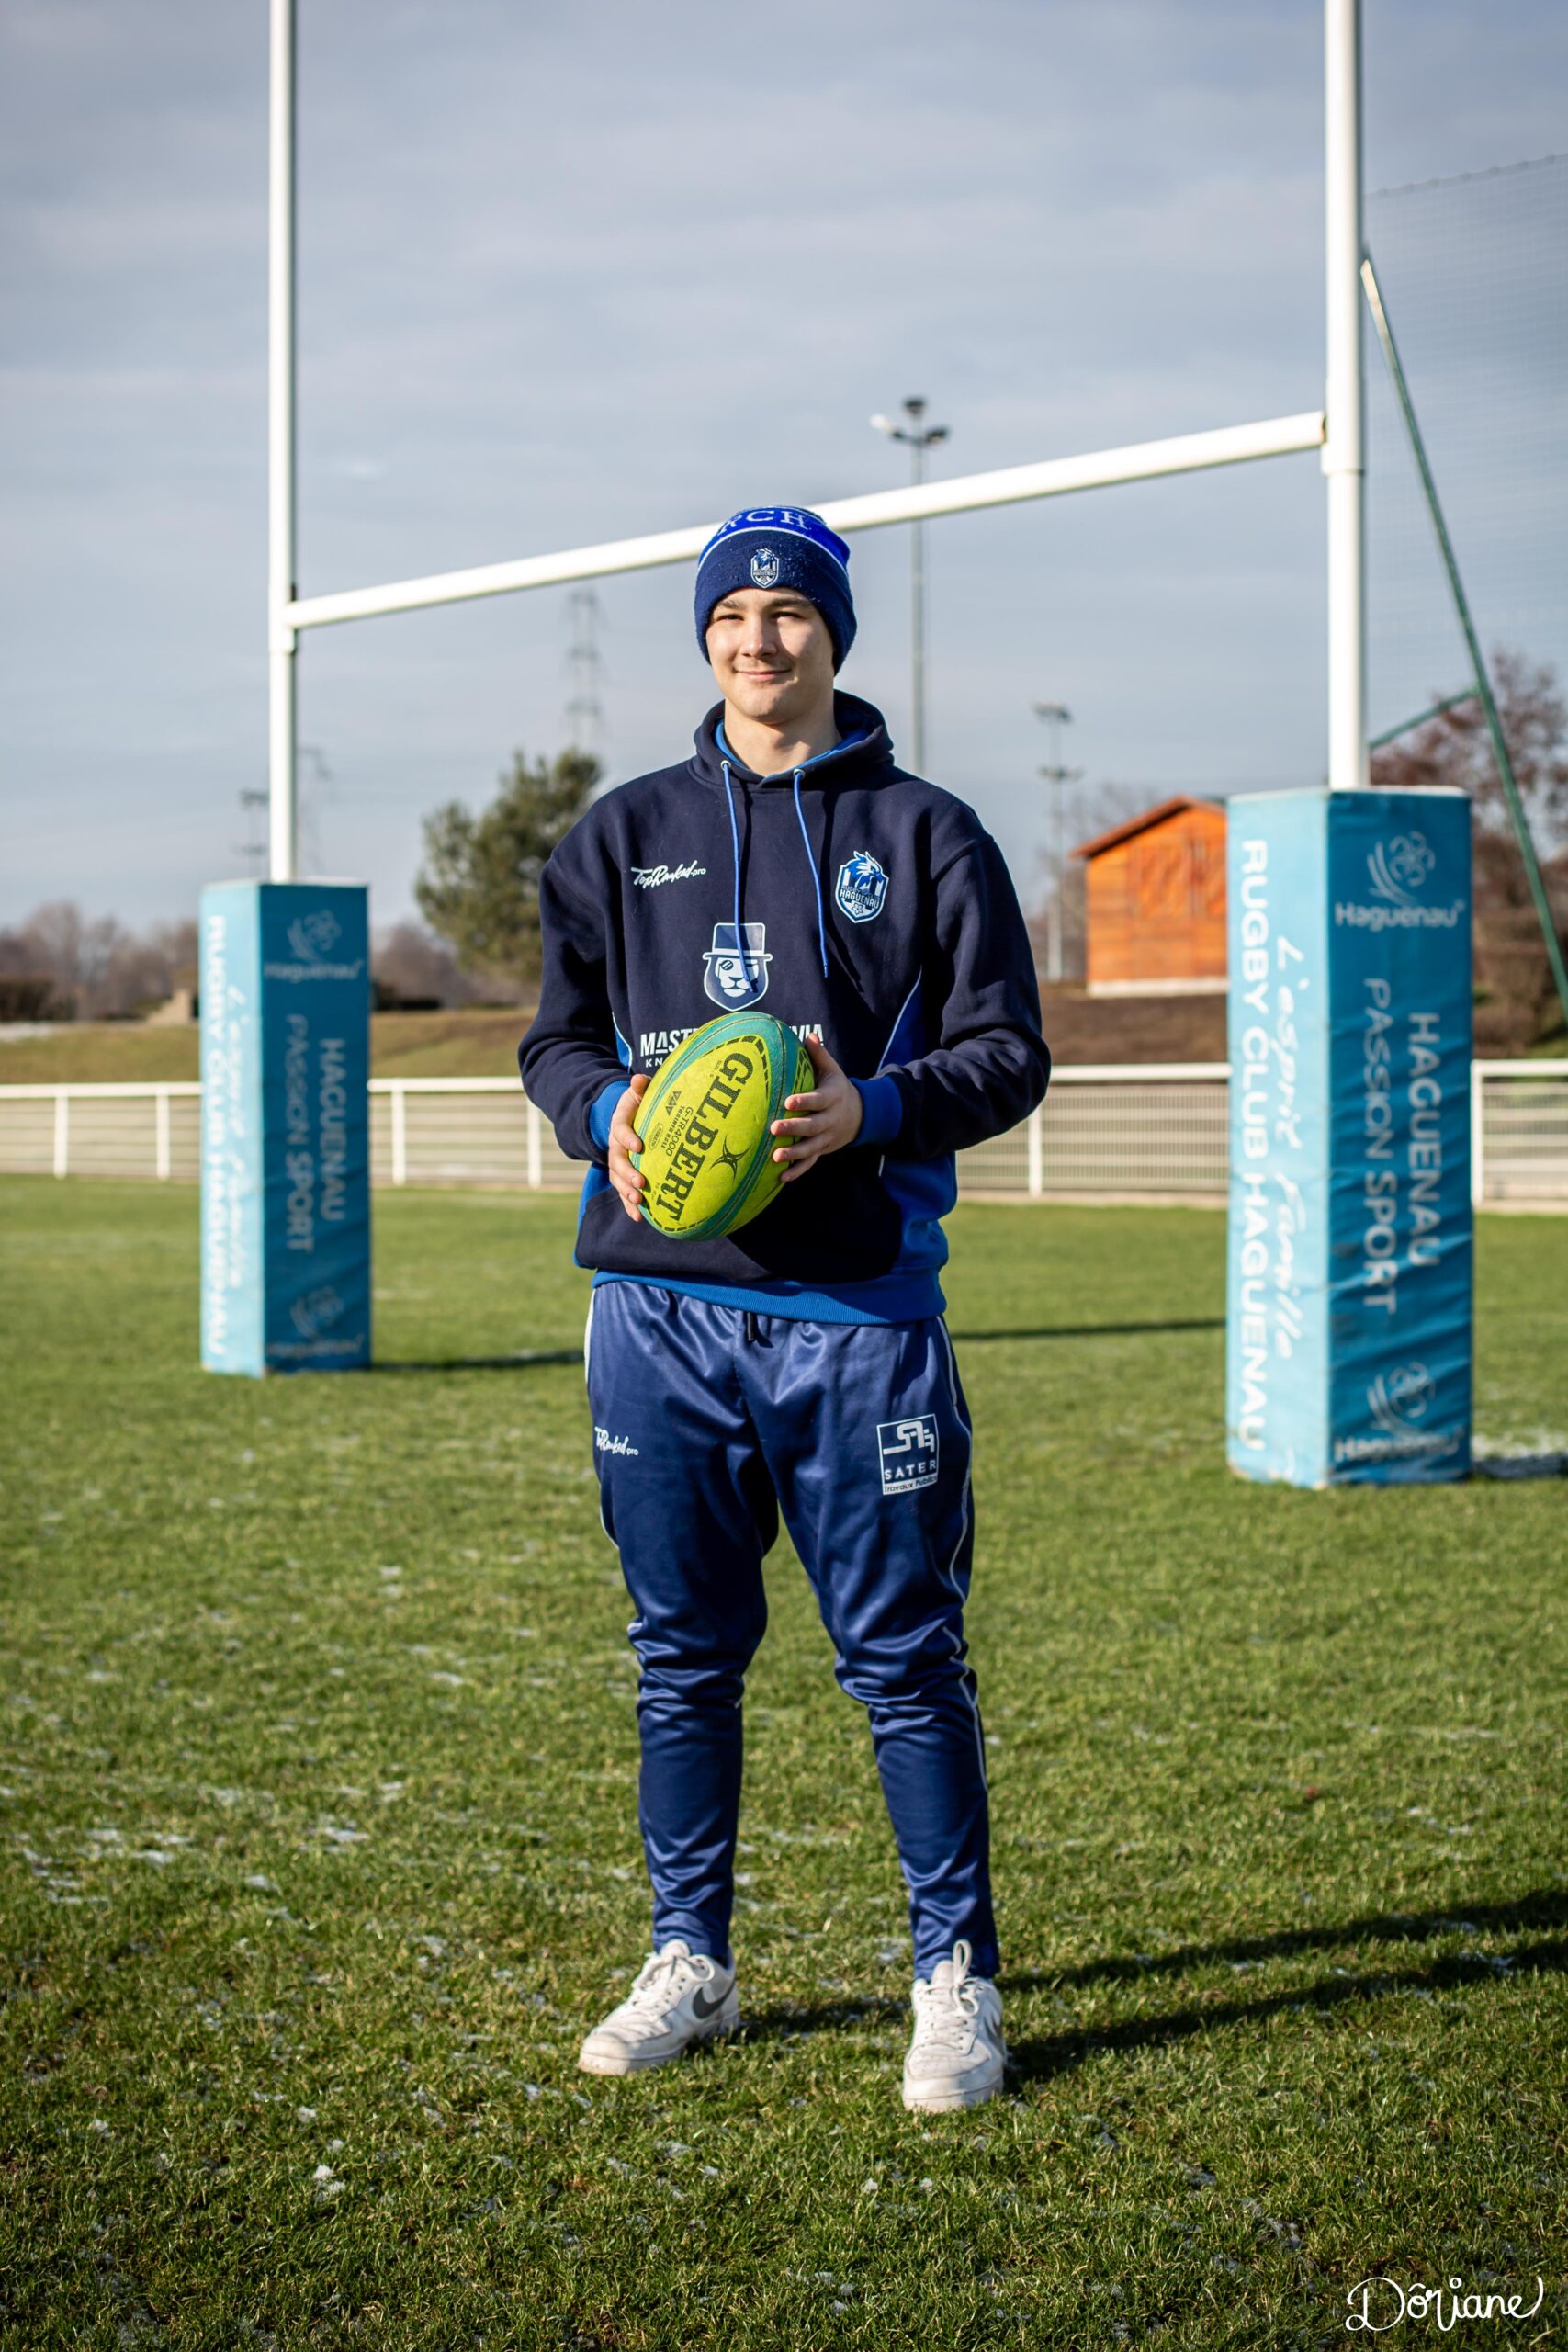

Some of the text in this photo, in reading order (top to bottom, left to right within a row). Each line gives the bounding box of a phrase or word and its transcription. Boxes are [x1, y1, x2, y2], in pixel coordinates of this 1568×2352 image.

[840, 888, 879, 910] HAGUENAU
[640, 1028, 698, 1057] MAST
[320, 1039, 345, 1220] HAGUENAU
[655, 1052, 754, 1221] GILBERT
[666, 1106, 694, 1156] G-TR4000
[1241, 840, 1269, 1451] RUGBY CLUB HAGUENAU
[1364, 978, 1397, 1315] PASSION SPORT
[1408, 1012, 1442, 1265] HAGUENAU
[286, 1151, 314, 1253] SPORT
[884, 1460, 937, 1480] SATER
